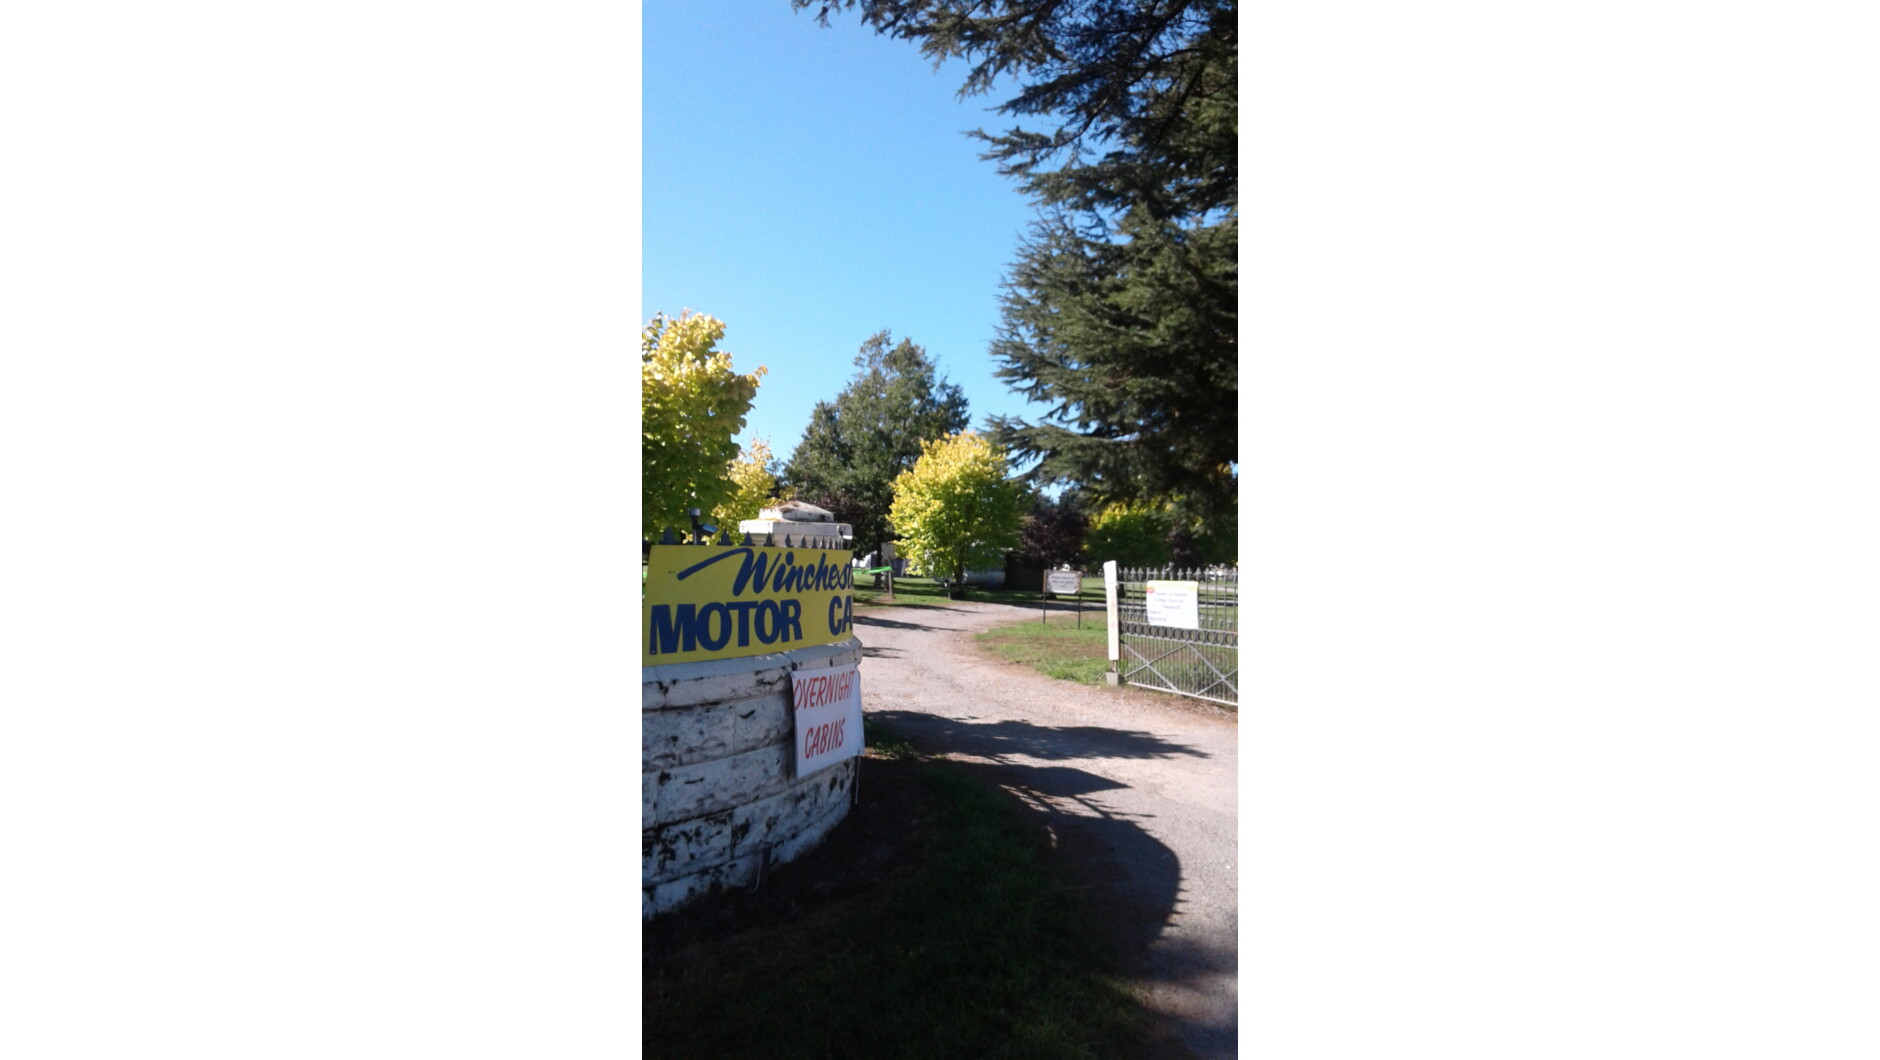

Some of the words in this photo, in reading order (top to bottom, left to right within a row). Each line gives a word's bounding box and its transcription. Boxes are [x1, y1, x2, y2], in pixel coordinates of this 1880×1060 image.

[650, 599, 803, 655] MOTOR
[828, 595, 853, 636] CA
[793, 670, 855, 711] OVERNIGHT
[804, 716, 846, 760] CABINS
